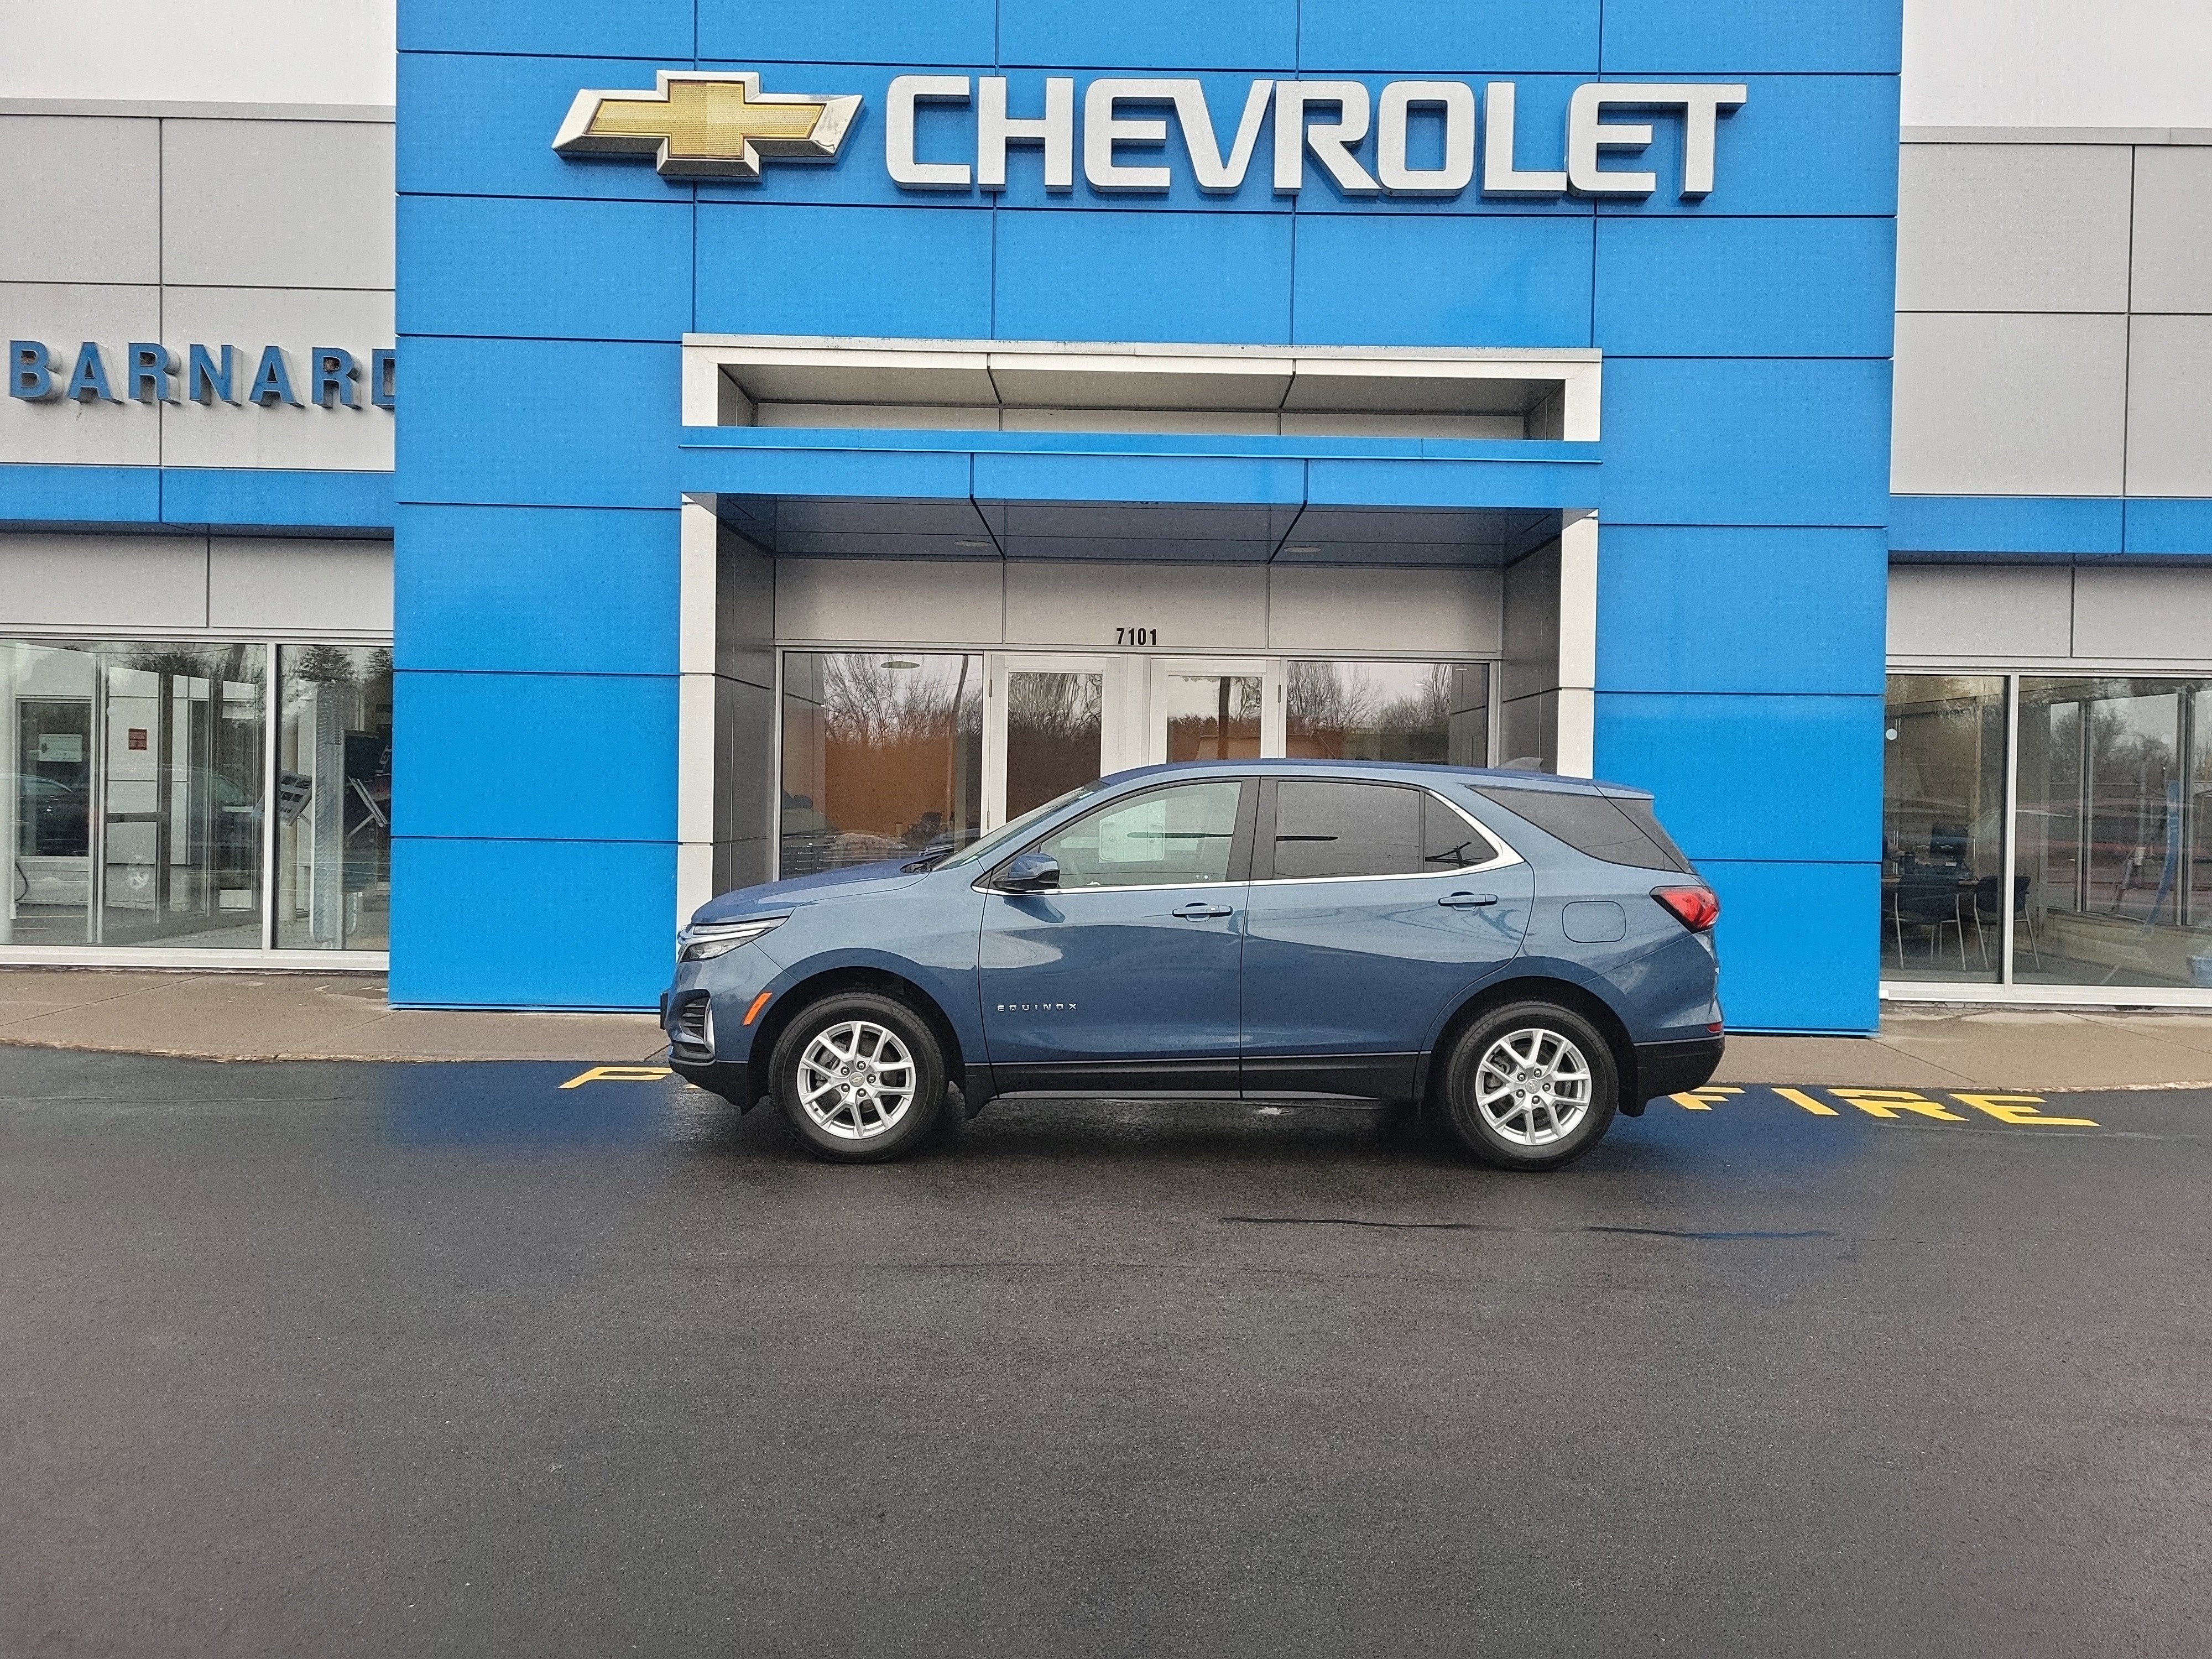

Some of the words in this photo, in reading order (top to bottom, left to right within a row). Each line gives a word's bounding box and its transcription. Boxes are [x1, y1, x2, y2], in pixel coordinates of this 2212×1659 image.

[886, 75, 1747, 198] CHEVROLET
[1116, 627, 1157, 646] 7101
[997, 1003, 1078, 1012] EQUINOX
[1667, 1086, 2102, 1127] FIRE
